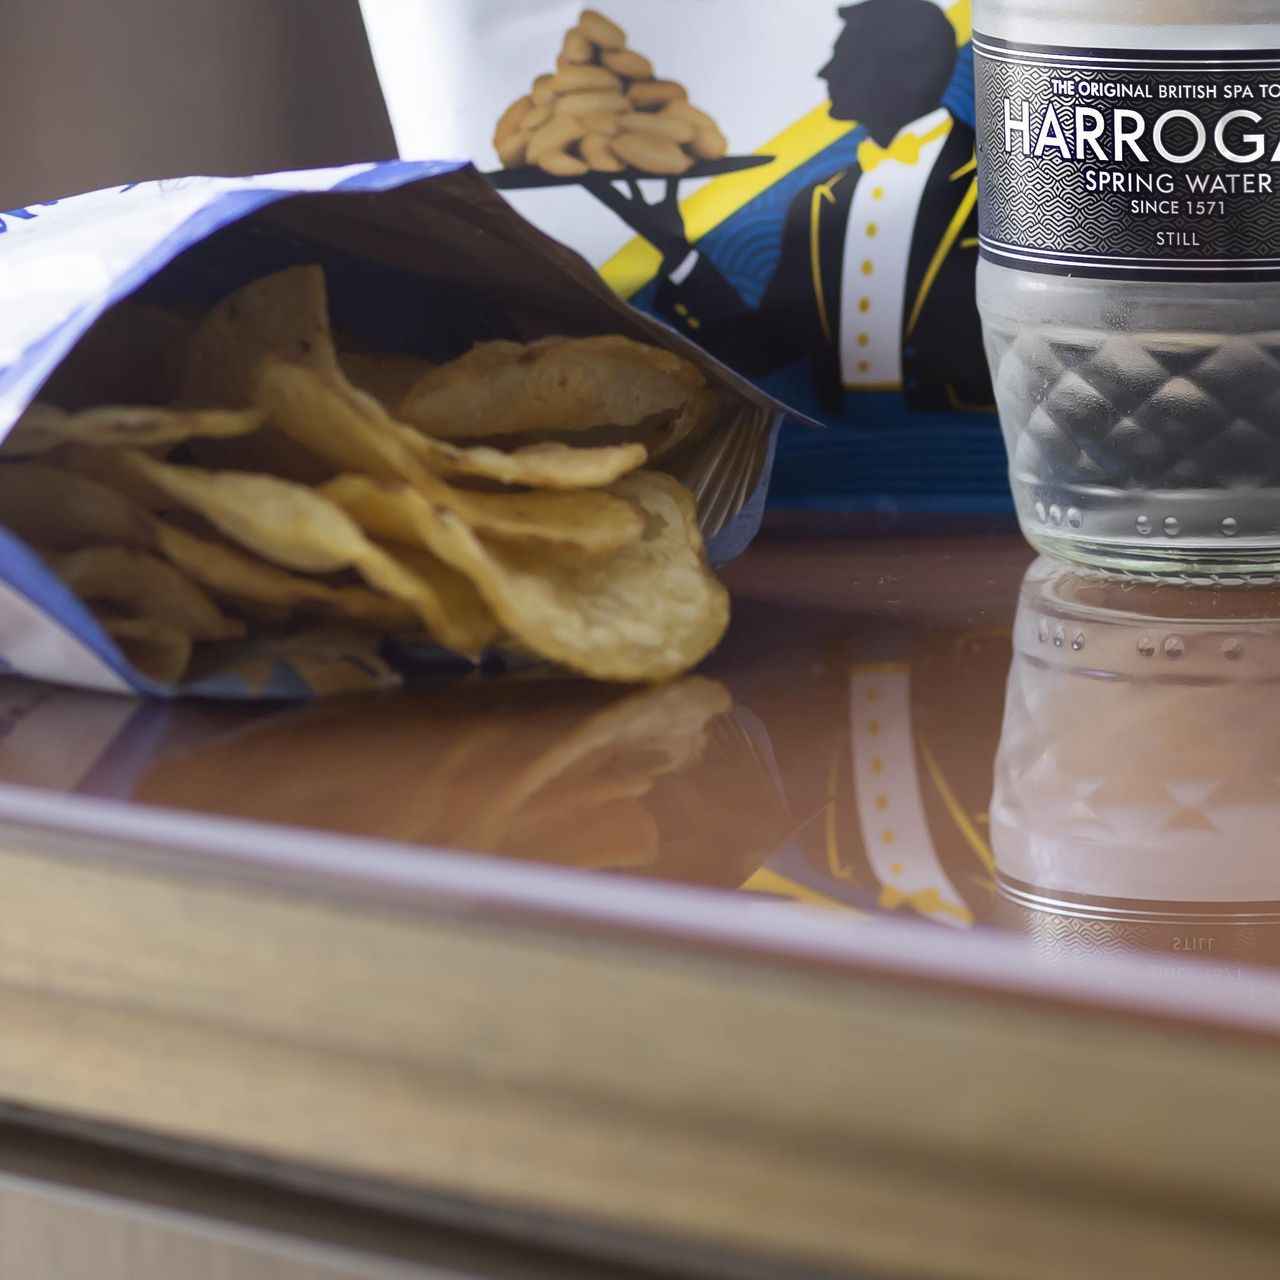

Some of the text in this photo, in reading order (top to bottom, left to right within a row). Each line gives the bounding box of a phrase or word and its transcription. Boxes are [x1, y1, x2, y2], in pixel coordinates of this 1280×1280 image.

[1052, 78, 1075, 96] THE
[1078, 80, 1153, 99] ORIGINAL
[1158, 84, 1217, 99] BRITISH
[1223, 84, 1254, 99] SPA
[1085, 170, 1273, 194] SPRING WATER
[1130, 199, 1226, 215] SINCE 1571
[1156, 231, 1201, 247] STILL
